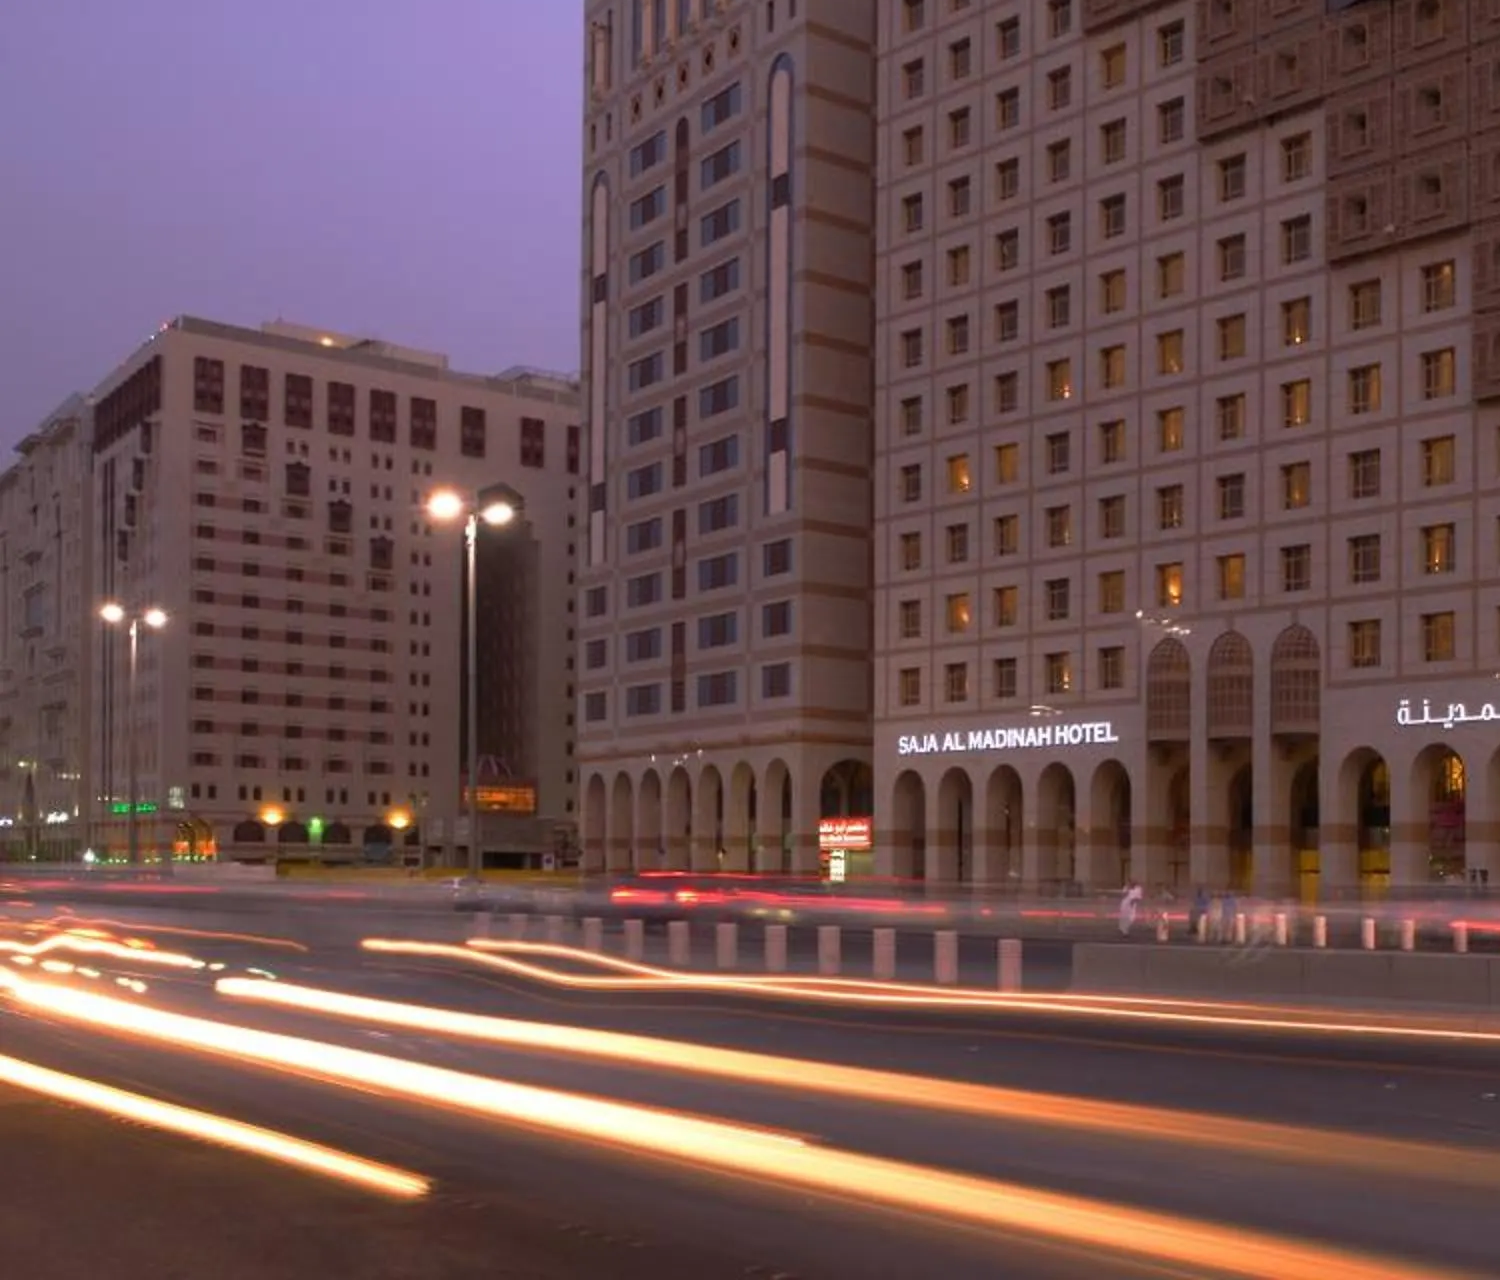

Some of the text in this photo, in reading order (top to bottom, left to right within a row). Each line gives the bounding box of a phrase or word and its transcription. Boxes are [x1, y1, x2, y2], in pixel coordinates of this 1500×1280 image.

[898, 722, 1119, 755] SAJA AL MADINAH HOTEL
